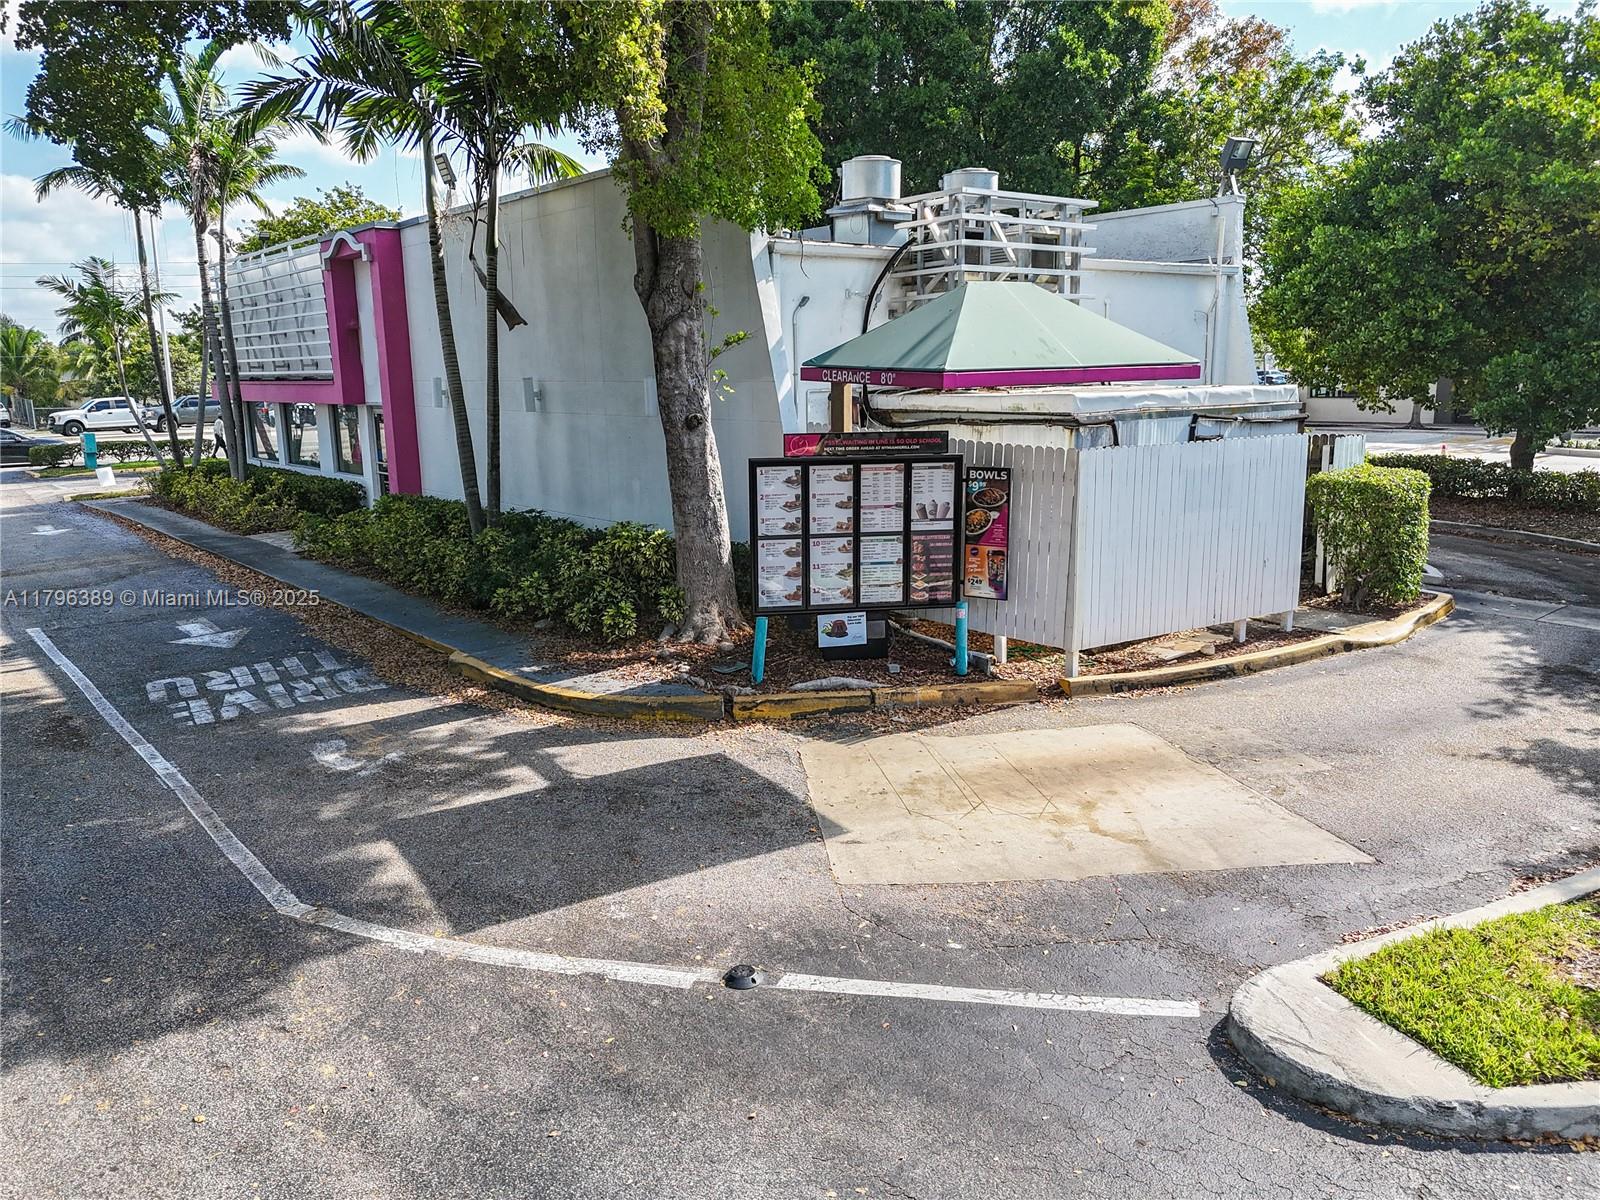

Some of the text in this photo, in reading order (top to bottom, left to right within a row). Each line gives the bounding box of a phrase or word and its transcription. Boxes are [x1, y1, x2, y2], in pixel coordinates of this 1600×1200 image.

[822, 369, 871, 383] CLEARANCE
[970, 470, 1008, 480] BOWLS
[145, 650, 345, 702] THRU
[167, 666, 391, 726] DRIVE
